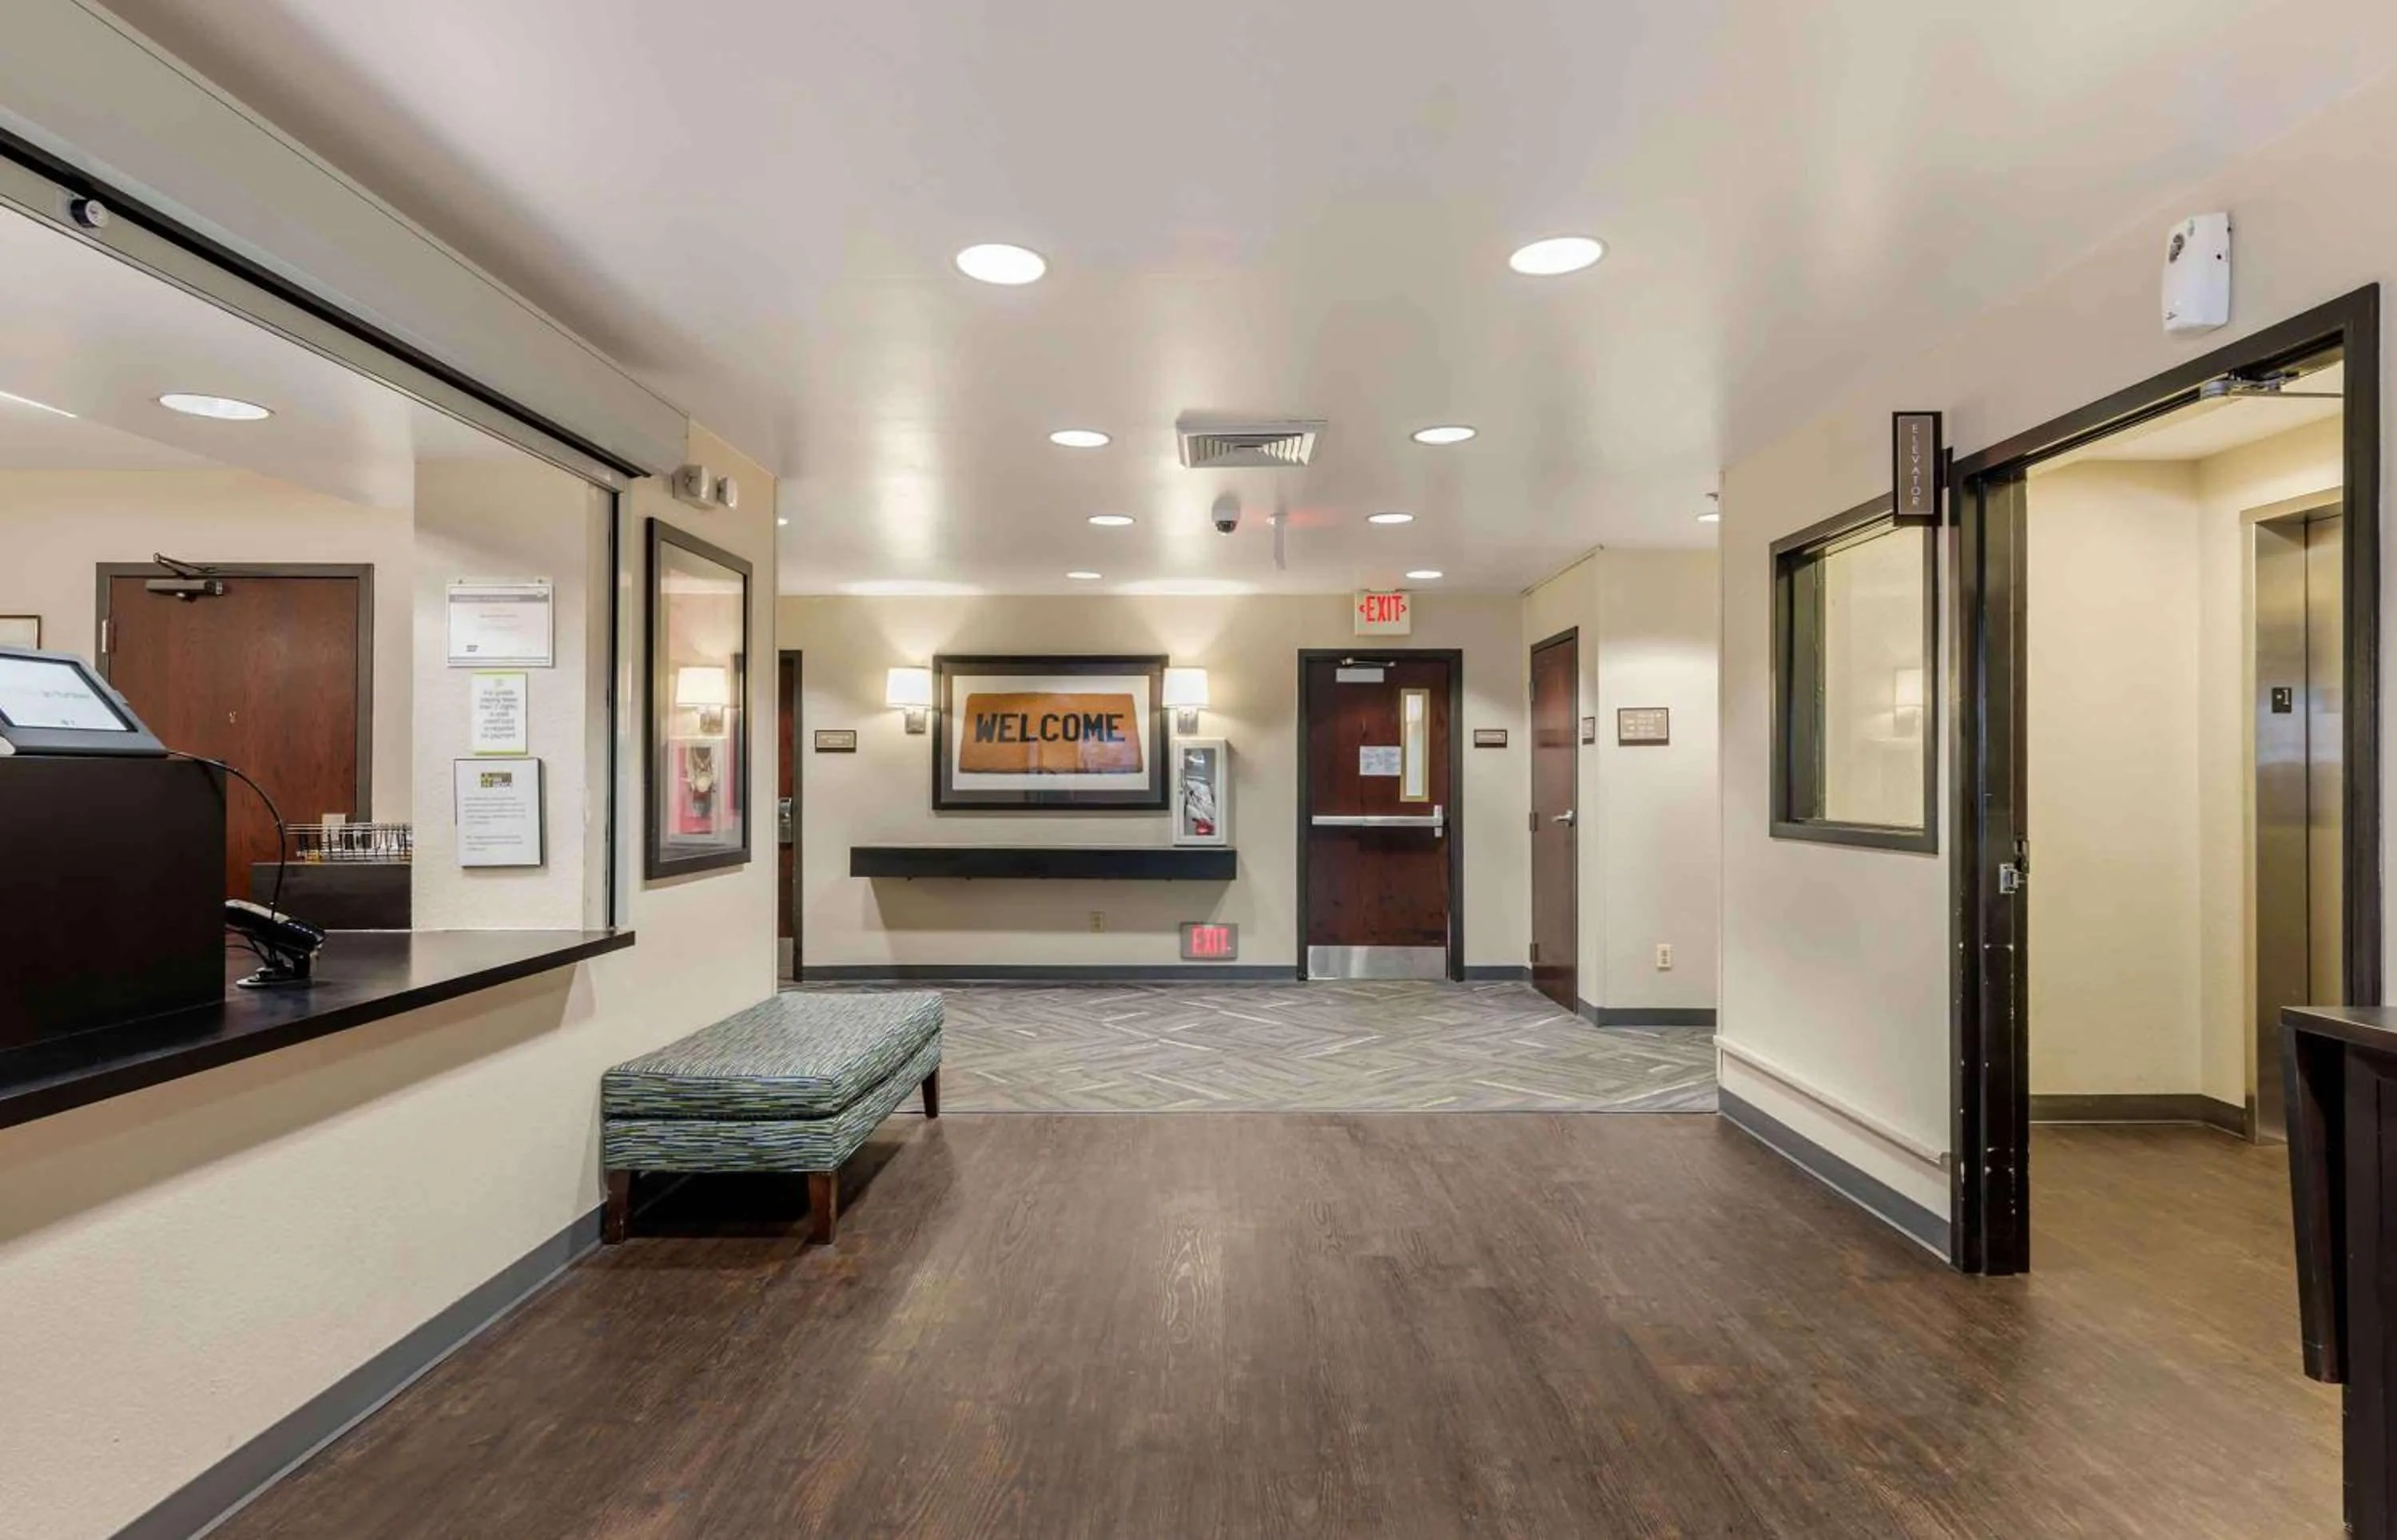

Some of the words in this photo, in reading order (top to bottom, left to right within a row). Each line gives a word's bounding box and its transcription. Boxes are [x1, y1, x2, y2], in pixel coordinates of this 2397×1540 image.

[1910, 423, 1922, 506] ELEVATOR
[1366, 594, 1402, 622] EXIT
[975, 713, 1127, 744] WELCOME
[1191, 927, 1228, 954] EXIT
